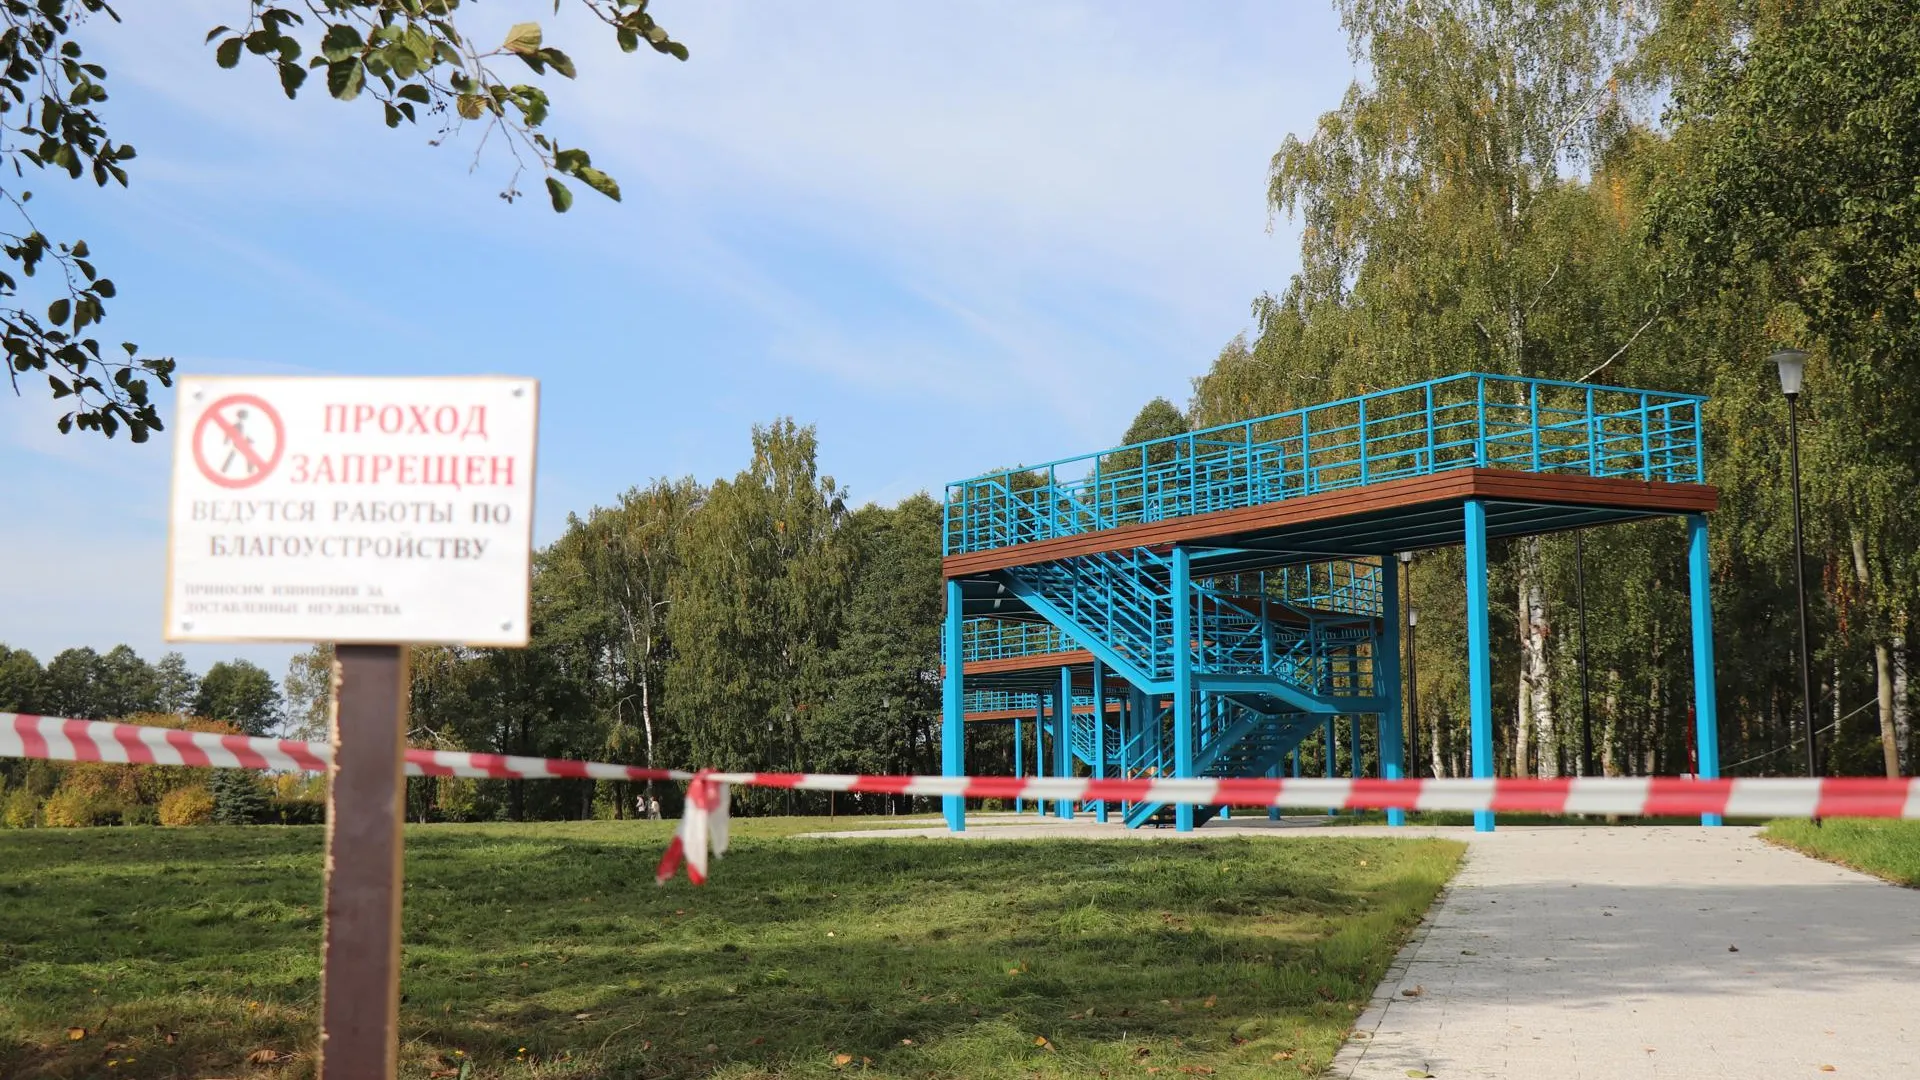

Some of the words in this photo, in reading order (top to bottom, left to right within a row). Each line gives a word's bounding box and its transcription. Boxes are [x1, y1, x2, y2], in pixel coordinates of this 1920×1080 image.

[323, 404, 488, 441] ПРОХОД
[290, 454, 515, 490] ЗАПРЕЩЕН
[191, 500, 316, 524] ВЕДУТСЯ
[332, 501, 453, 523] РАБОТЫ
[471, 503, 512, 524] ПО
[209, 532, 490, 560] БЛАГОУСТРОЙСТВУ
[185, 584, 265, 597] ПРИНОСИМ
[367, 585, 384, 597] ЗА
